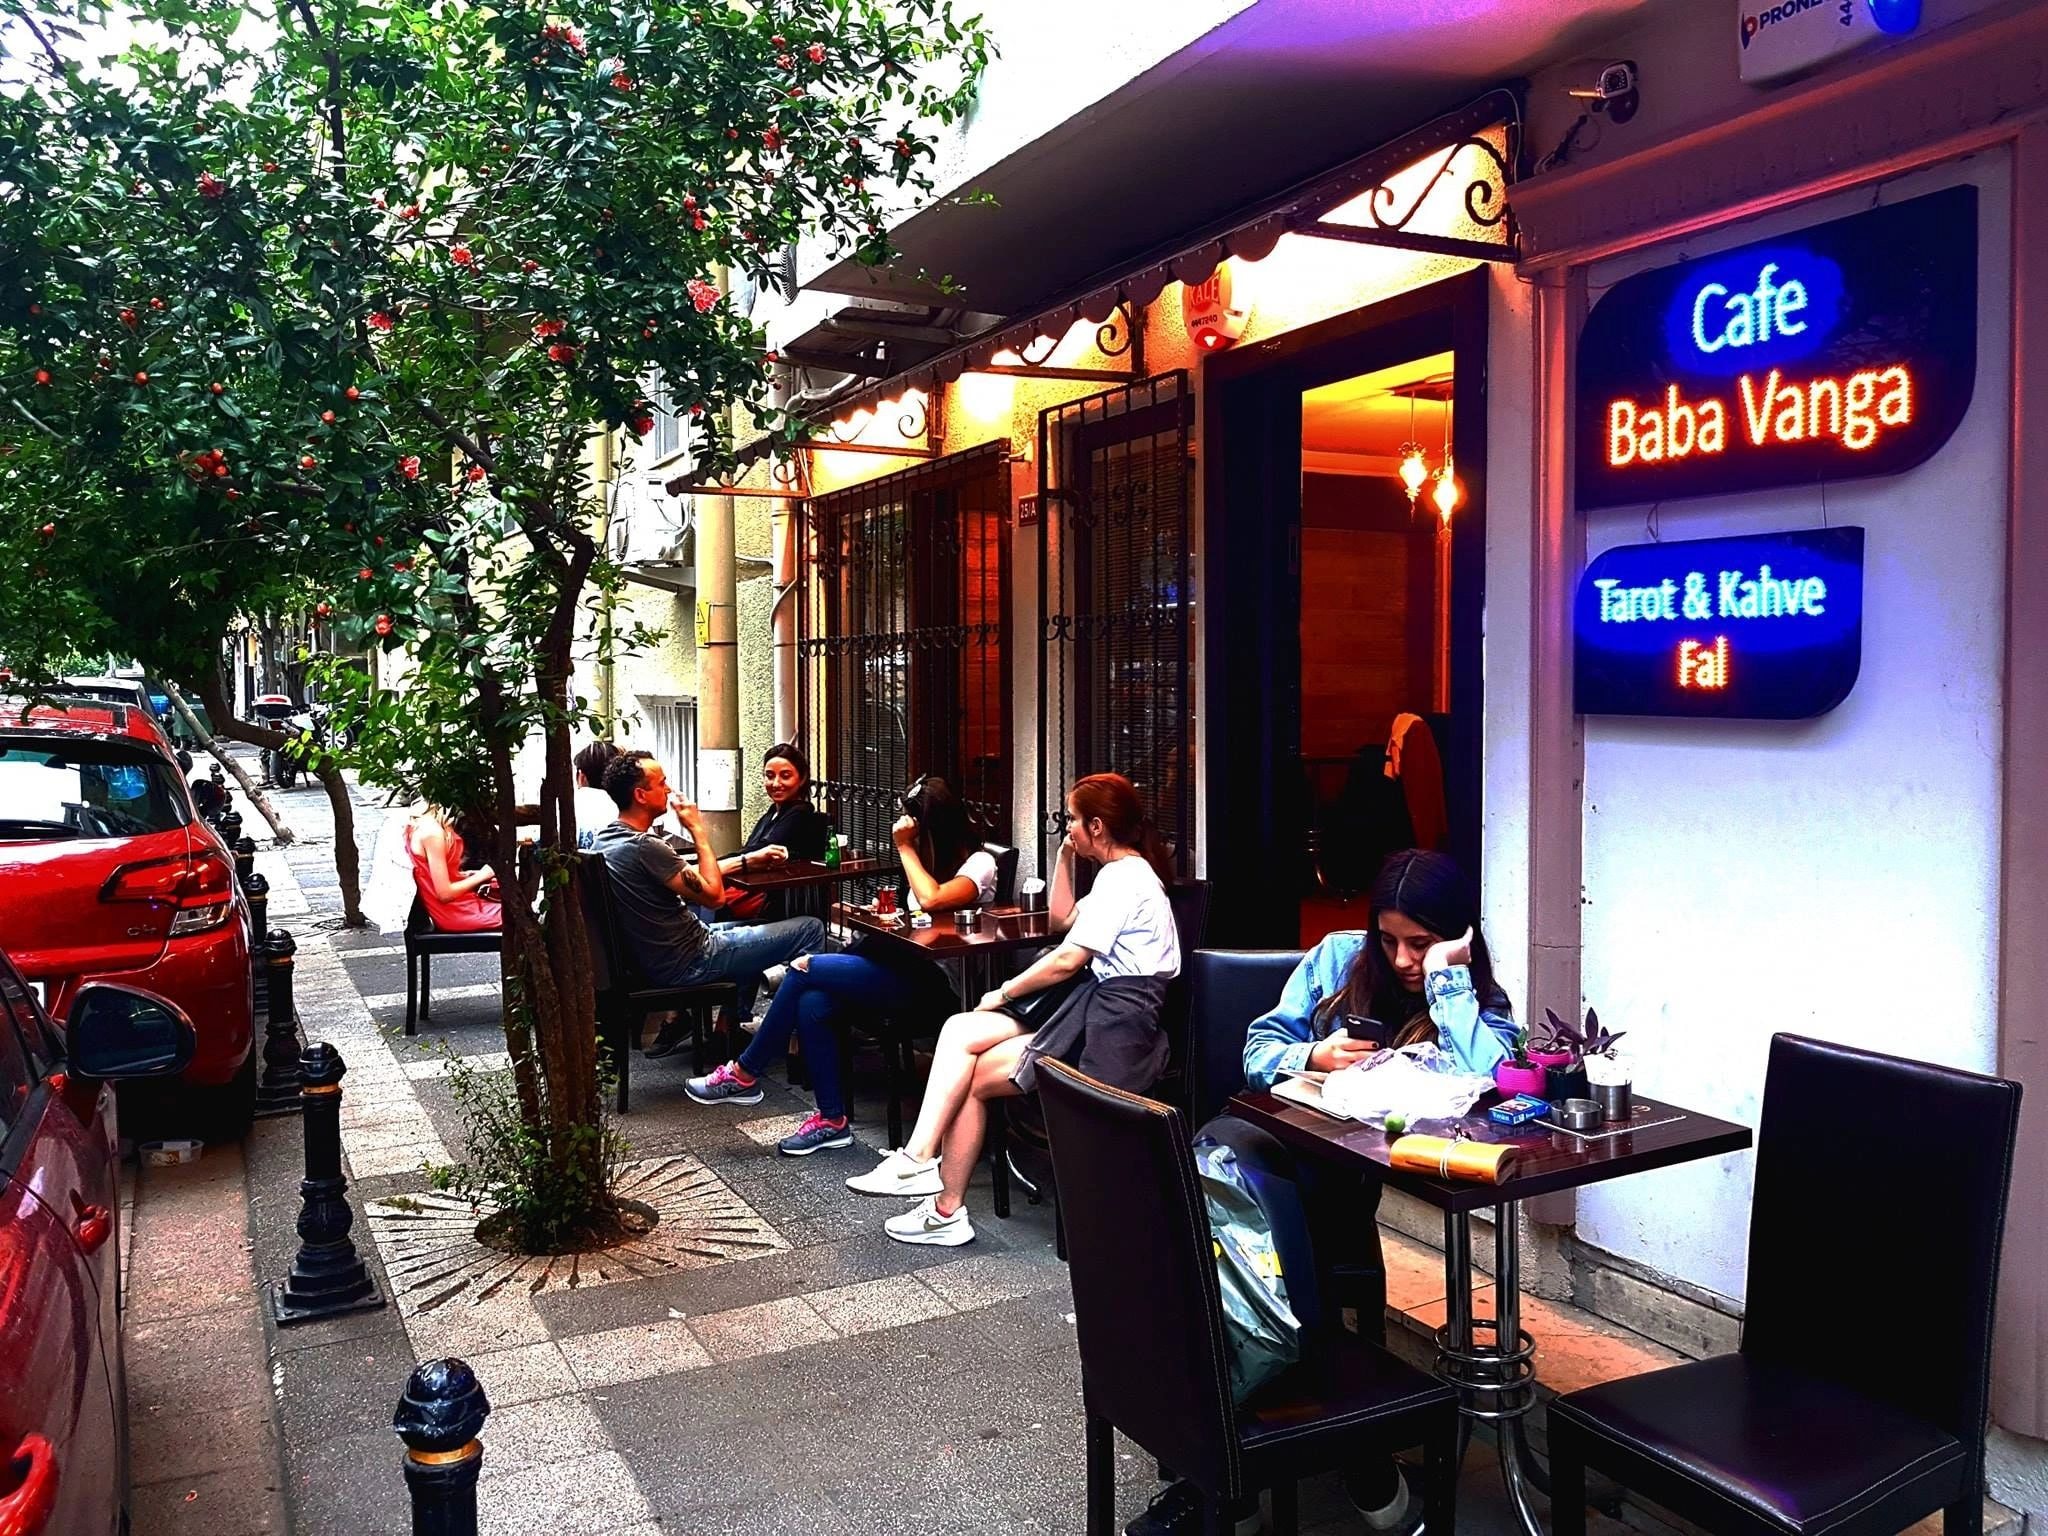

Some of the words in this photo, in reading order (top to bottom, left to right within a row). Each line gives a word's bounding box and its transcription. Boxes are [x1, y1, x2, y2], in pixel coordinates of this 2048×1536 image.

[1839, 0, 1853, 26] 44
[1692, 263, 1808, 353] Cafe
[1610, 384, 1724, 466] Baba
[1741, 366, 1910, 450] Vanga
[1020, 501, 1037, 518] 25/A
[1594, 578, 1680, 623] Tarot
[1682, 571, 1713, 620] &
[1719, 565, 1827, 619] Kahve
[1679, 635, 1728, 688] Fal
